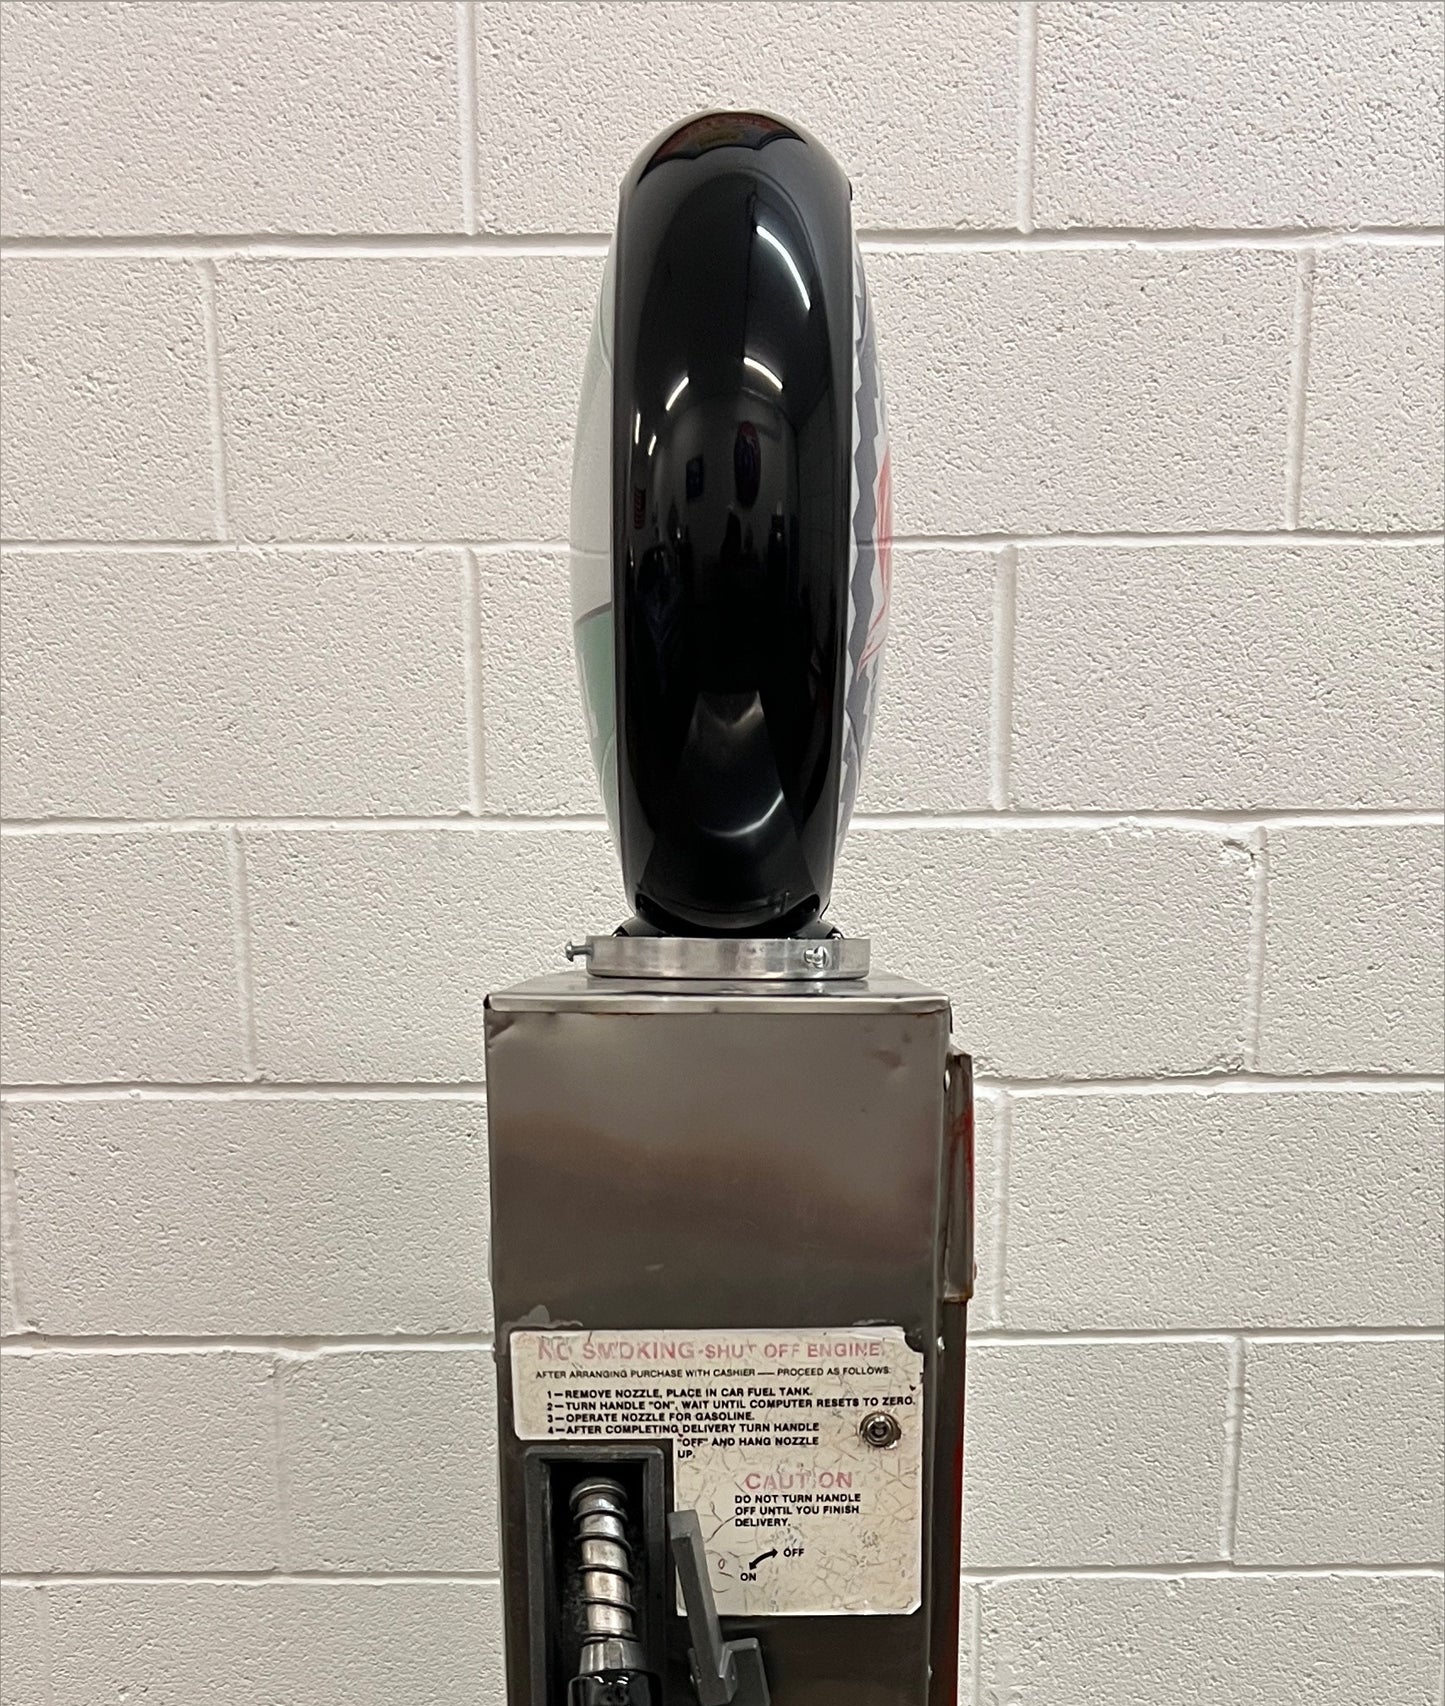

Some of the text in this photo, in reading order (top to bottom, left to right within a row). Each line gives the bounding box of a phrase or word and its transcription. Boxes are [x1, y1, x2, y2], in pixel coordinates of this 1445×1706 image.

[764, 1342, 800, 1358] OFF
[535, 1370, 567, 1379] AFTER
[569, 1369, 628, 1379] ARRANGING
[630, 1369, 683, 1378] PURCHASE
[685, 1369, 711, 1378] WITH
[713, 1368, 756, 1377] CASHIER
[777, 1367, 823, 1376] PROCEED
[826, 1367, 840, 1376] AS
[615, 1389, 663, 1399] NOZZLE,
[666, 1388, 702, 1398] PLACE
[705, 1388, 717, 1397] IN
[720, 1387, 744, 1397] CAR
[747, 1387, 776, 1397] FUEL
[779, 1386, 813, 1396] TANK.
[600, 1401, 646, 1411] HANDLE
[681, 1400, 710, 1410] WAIT
[713, 1399, 747, 1409] UNTIL
[749, 1399, 813, 1408] COMPUTER
[816, 1397, 860, 1407] RESETS
[863, 1397, 879, 1406] TO
[881, 1396, 916, 1406] ZERO.
[621, 1413, 665, 1422] NOZZLE
[668, 1412, 692, 1422] FOR
[695, 1411, 755, 1421] GASOLINE.
[605, 1424, 679, 1434] COMPLETING
[682, 1423, 736, 1433] DELIVERY
[739, 1422, 770, 1432] TURN
[773, 1422, 820, 1431] HANDLE
[677, 1436, 820, 1447] "OFF" AND HANG NOZZLE
[677, 1450, 695, 1458] UP.
[735, 1493, 861, 1504] DO NOT TURN HANDLE
[735, 1505, 860, 1516] OFF UNTIL YOU FINISH
[735, 1518, 791, 1527] DELIVERY.
[783, 1548, 805, 1557] OFF
[740, 1572, 757, 1581] ON
